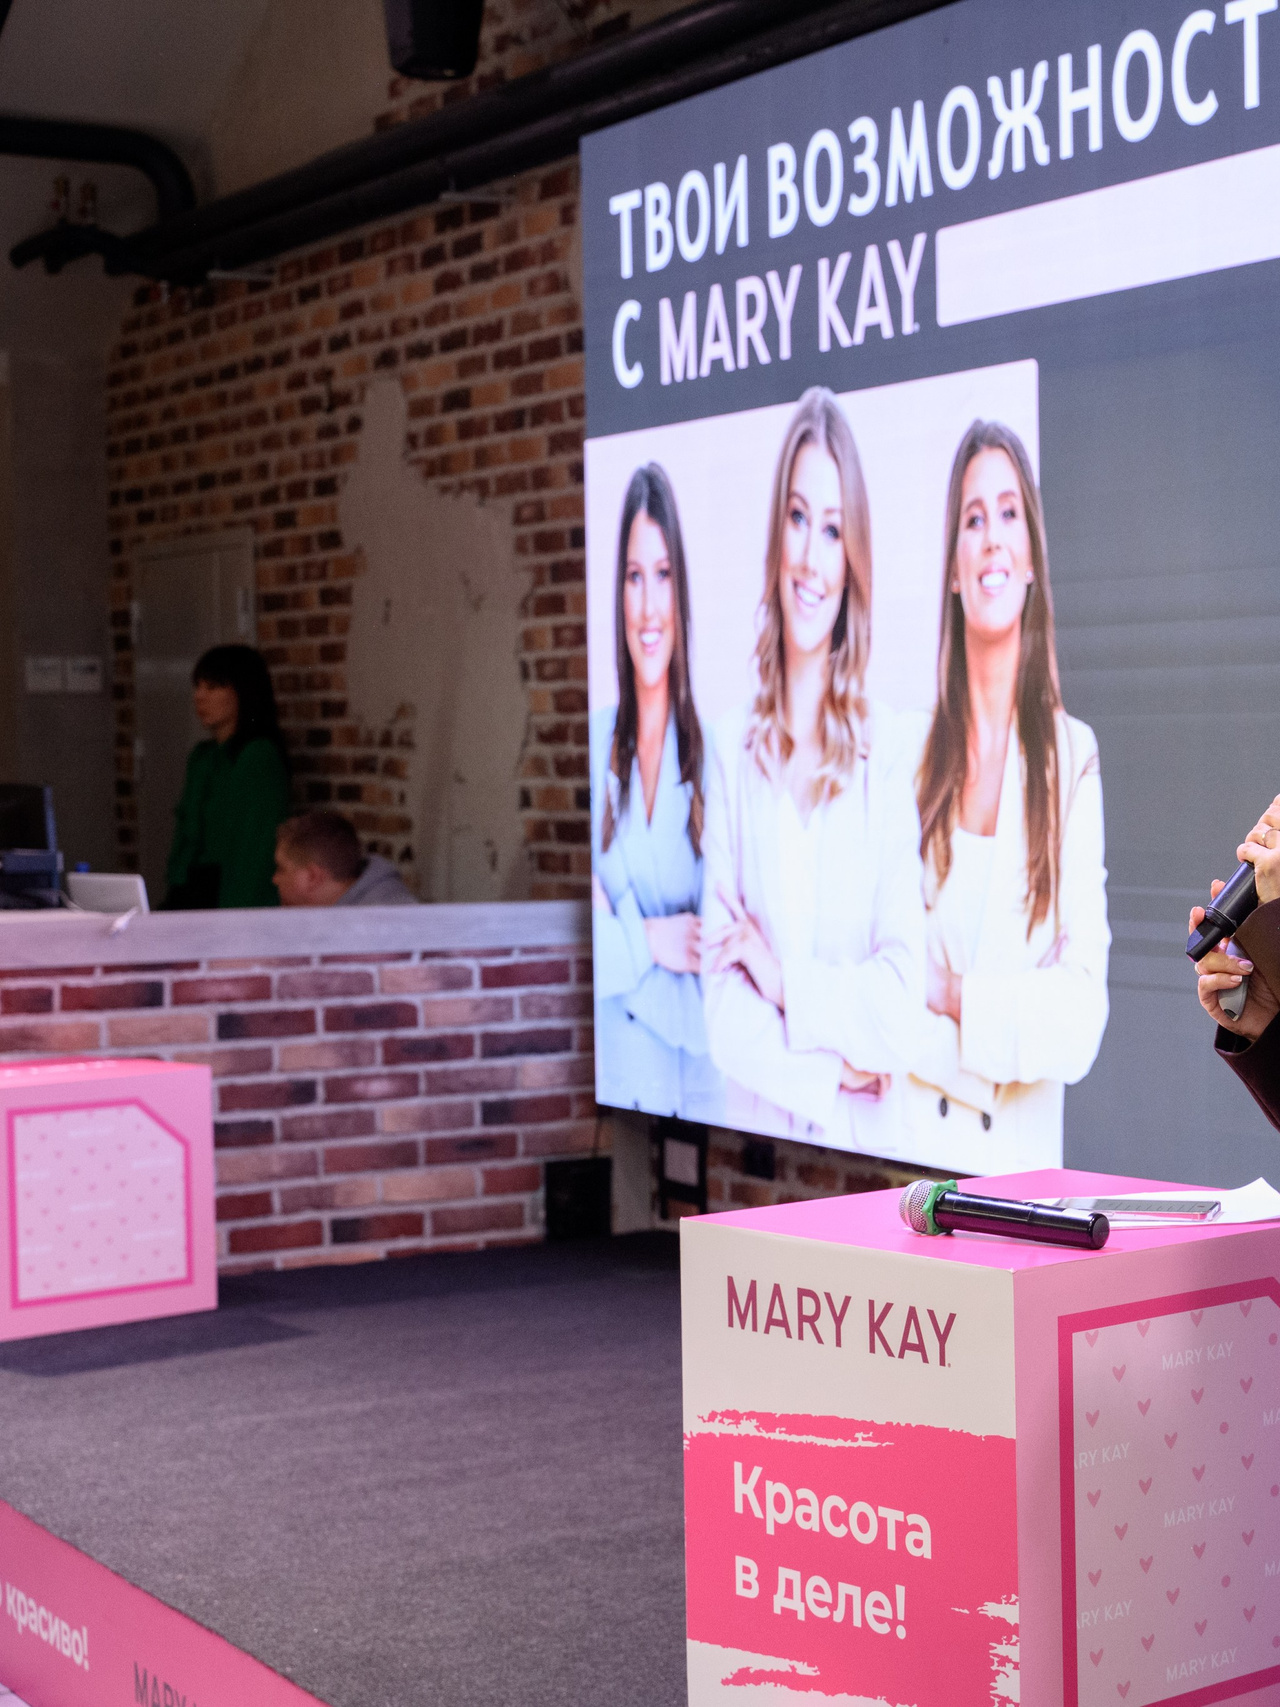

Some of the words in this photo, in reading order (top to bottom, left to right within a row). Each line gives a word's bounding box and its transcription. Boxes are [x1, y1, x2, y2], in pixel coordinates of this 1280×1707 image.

[609, 154, 750, 279] ТВОИ
[612, 298, 644, 389] С
[658, 264, 803, 386] MARY
[817, 231, 928, 353] KAY
[727, 1275, 852, 1349] MARY
[868, 1299, 957, 1367] KAY
[1161, 1348, 1203, 1371] MARY
[1207, 1341, 1234, 1361] KAY
[1074, 1449, 1098, 1469] RY
[1102, 1442, 1130, 1463] KAY
[733, 1461, 932, 1560] Красота
[1163, 1503, 1203, 1529] MARY
[1208, 1496, 1236, 1517] KAY
[6, 1582, 89, 1672] красиво!
[735, 1555, 759, 1598] в
[773, 1565, 906, 1639] деле!
[1076, 1607, 1100, 1629] RY
[1104, 1600, 1132, 1621] KAY
[1166, 1658, 1205, 1683] MARY
[1209, 1647, 1238, 1669] KAY
